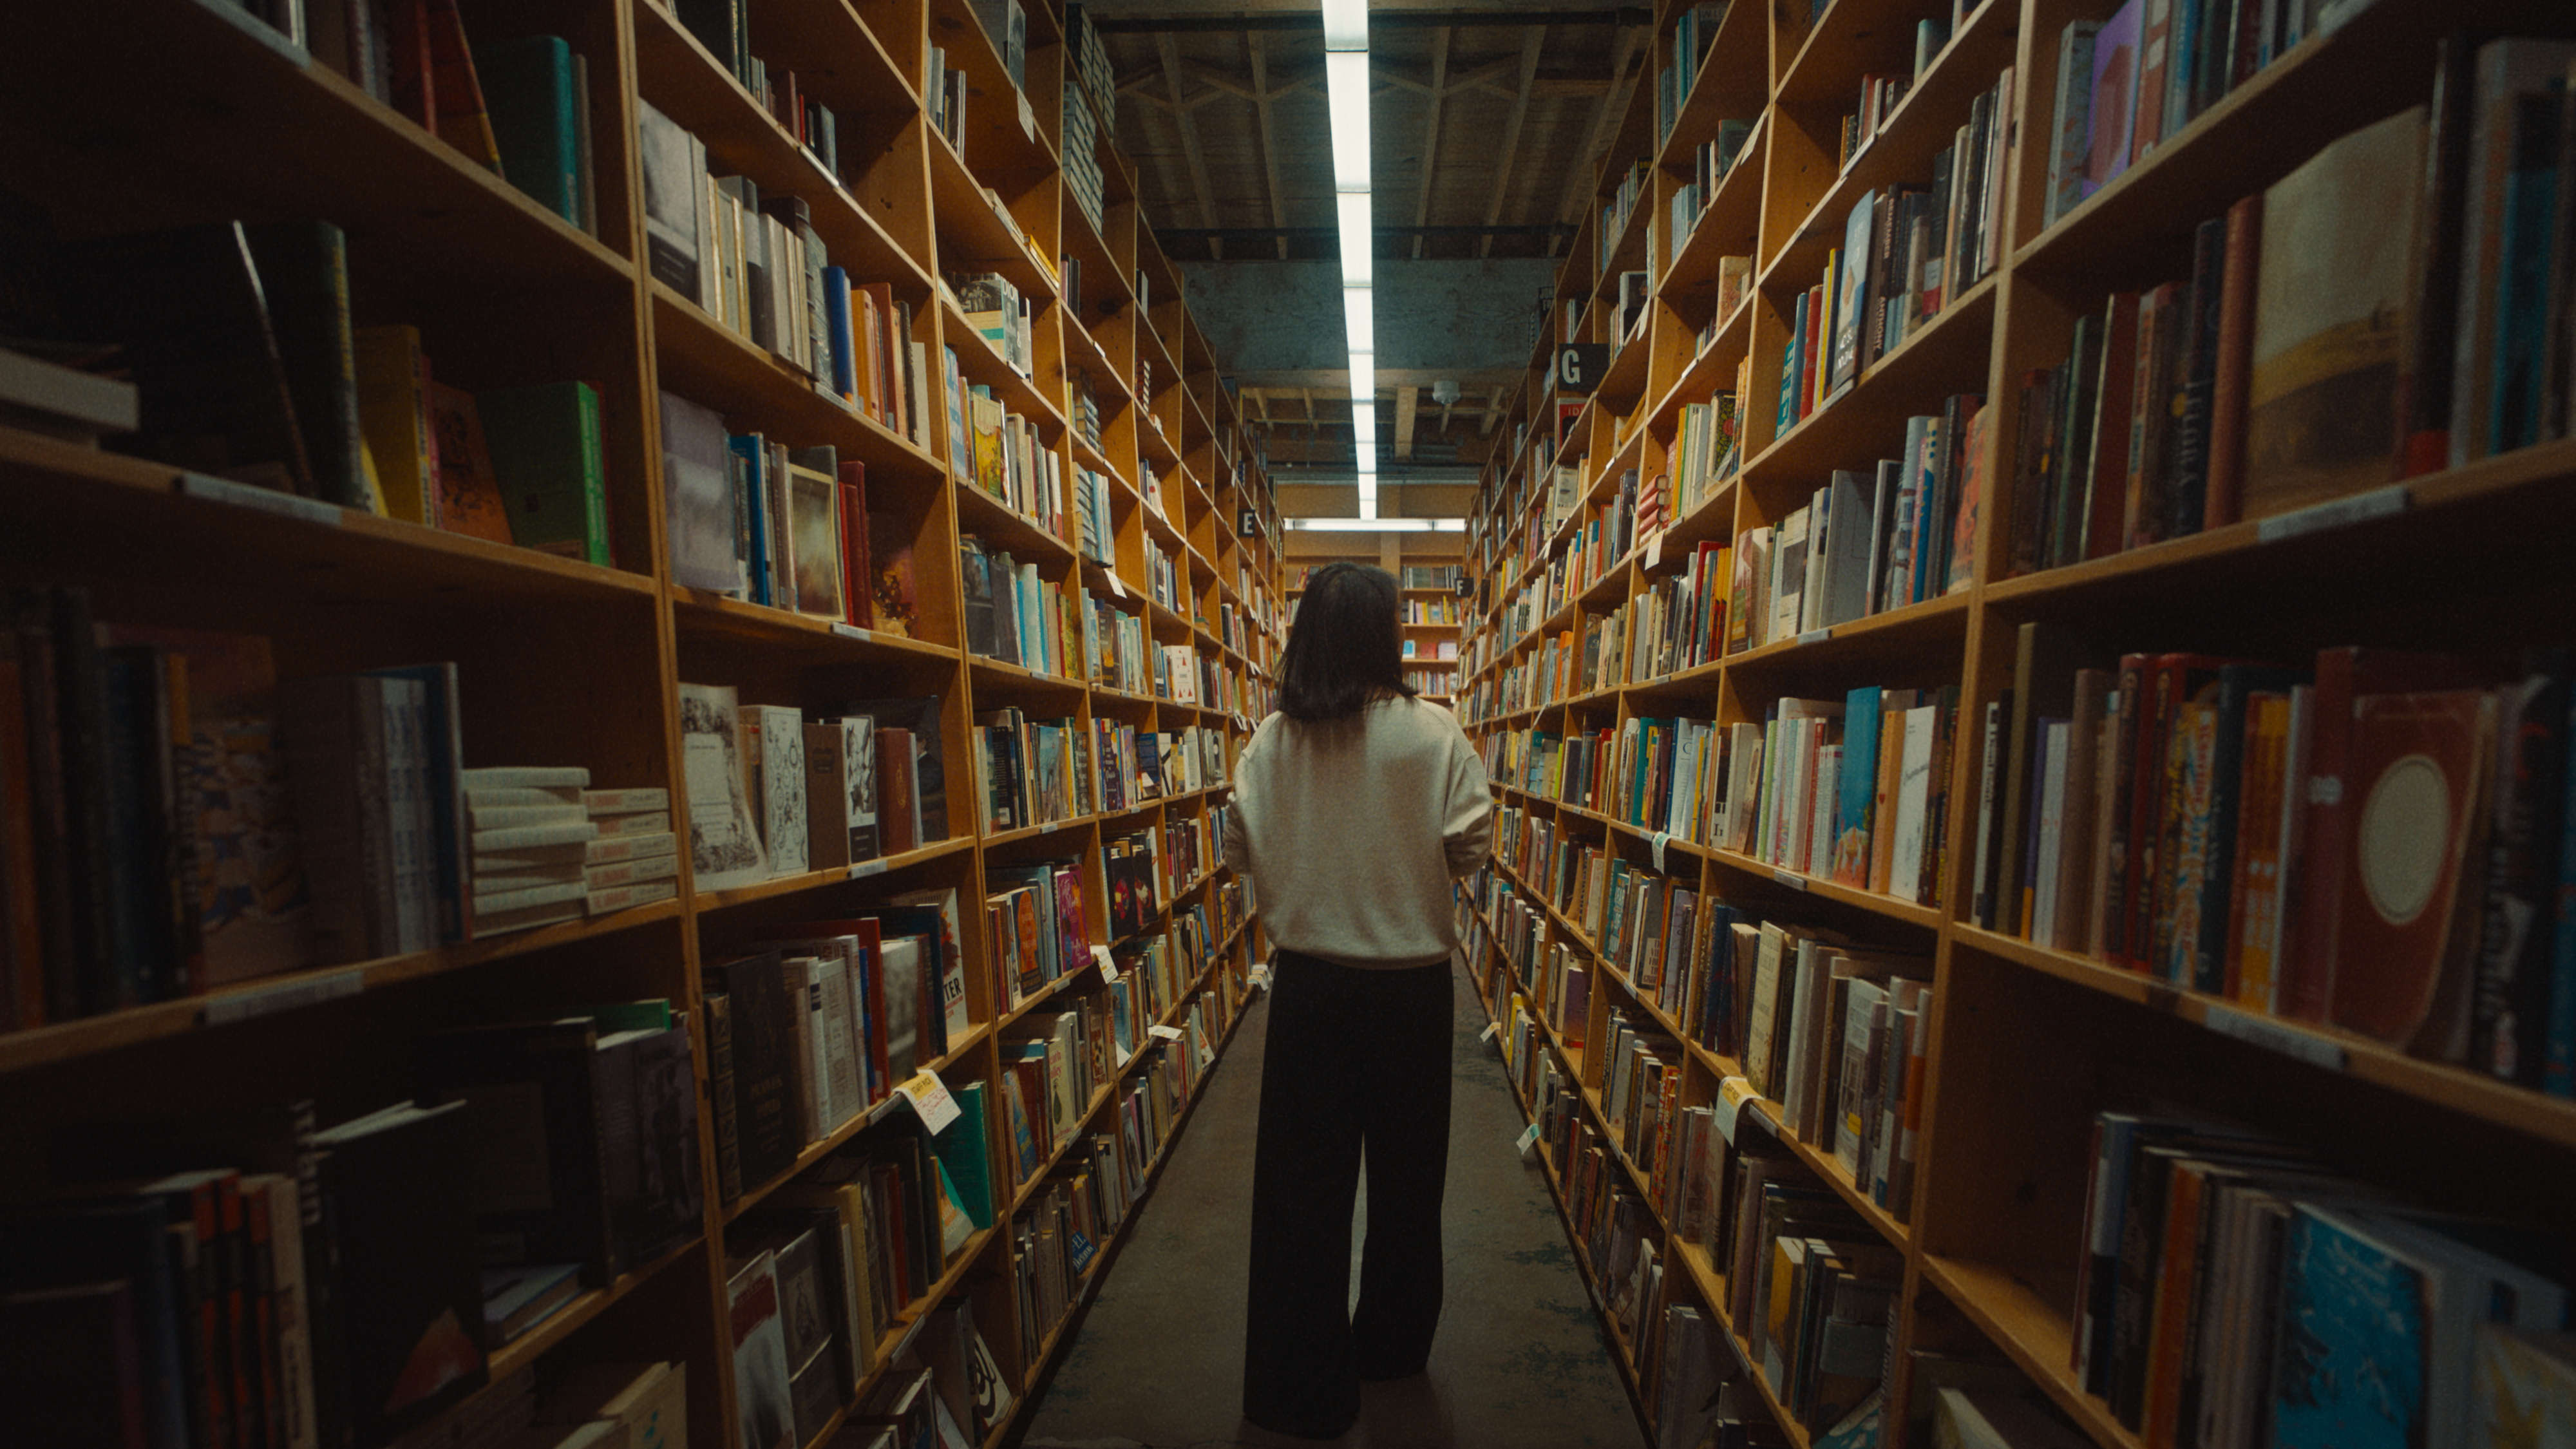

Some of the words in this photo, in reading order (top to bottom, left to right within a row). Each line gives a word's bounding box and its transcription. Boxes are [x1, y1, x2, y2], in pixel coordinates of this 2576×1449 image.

[1874, 296, 1886, 351] ANTHONY
[1561, 349, 1581, 384] G
[1243, 513, 1253, 535] E
[1456, 580, 1464, 596] F
[943, 977, 961, 1002] TER
